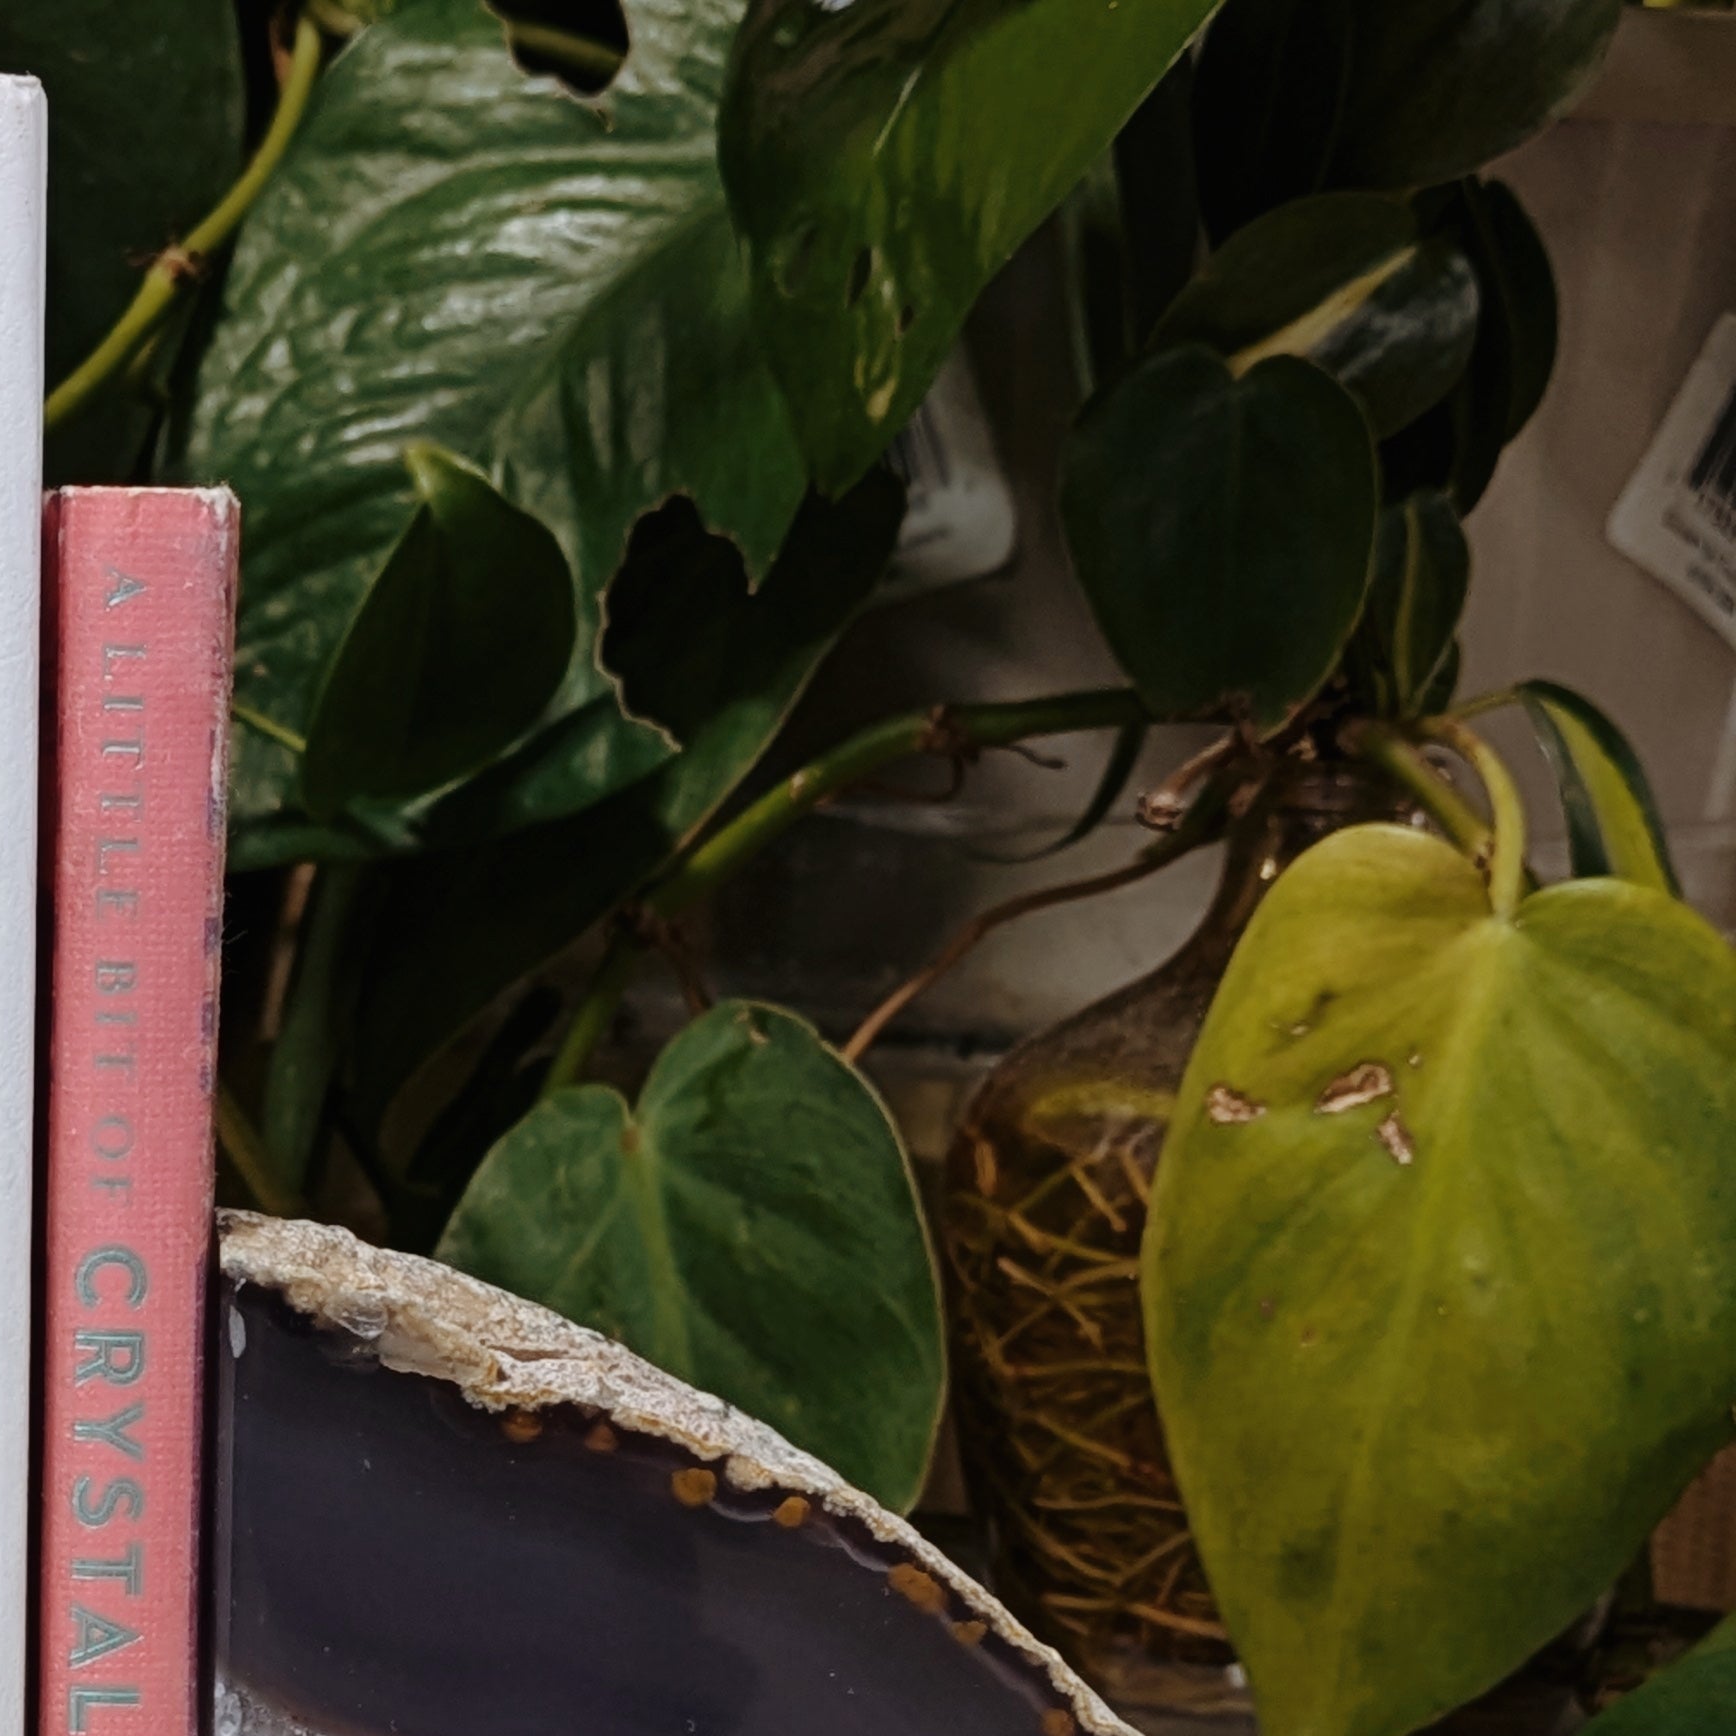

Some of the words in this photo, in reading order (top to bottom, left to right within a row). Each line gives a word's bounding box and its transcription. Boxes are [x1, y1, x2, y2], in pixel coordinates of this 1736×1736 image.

[103, 565, 148, 612] A
[96, 643, 147, 921] LITTLE
[93, 957, 139, 1085] BIT
[89, 1114, 135, 1205] OF
